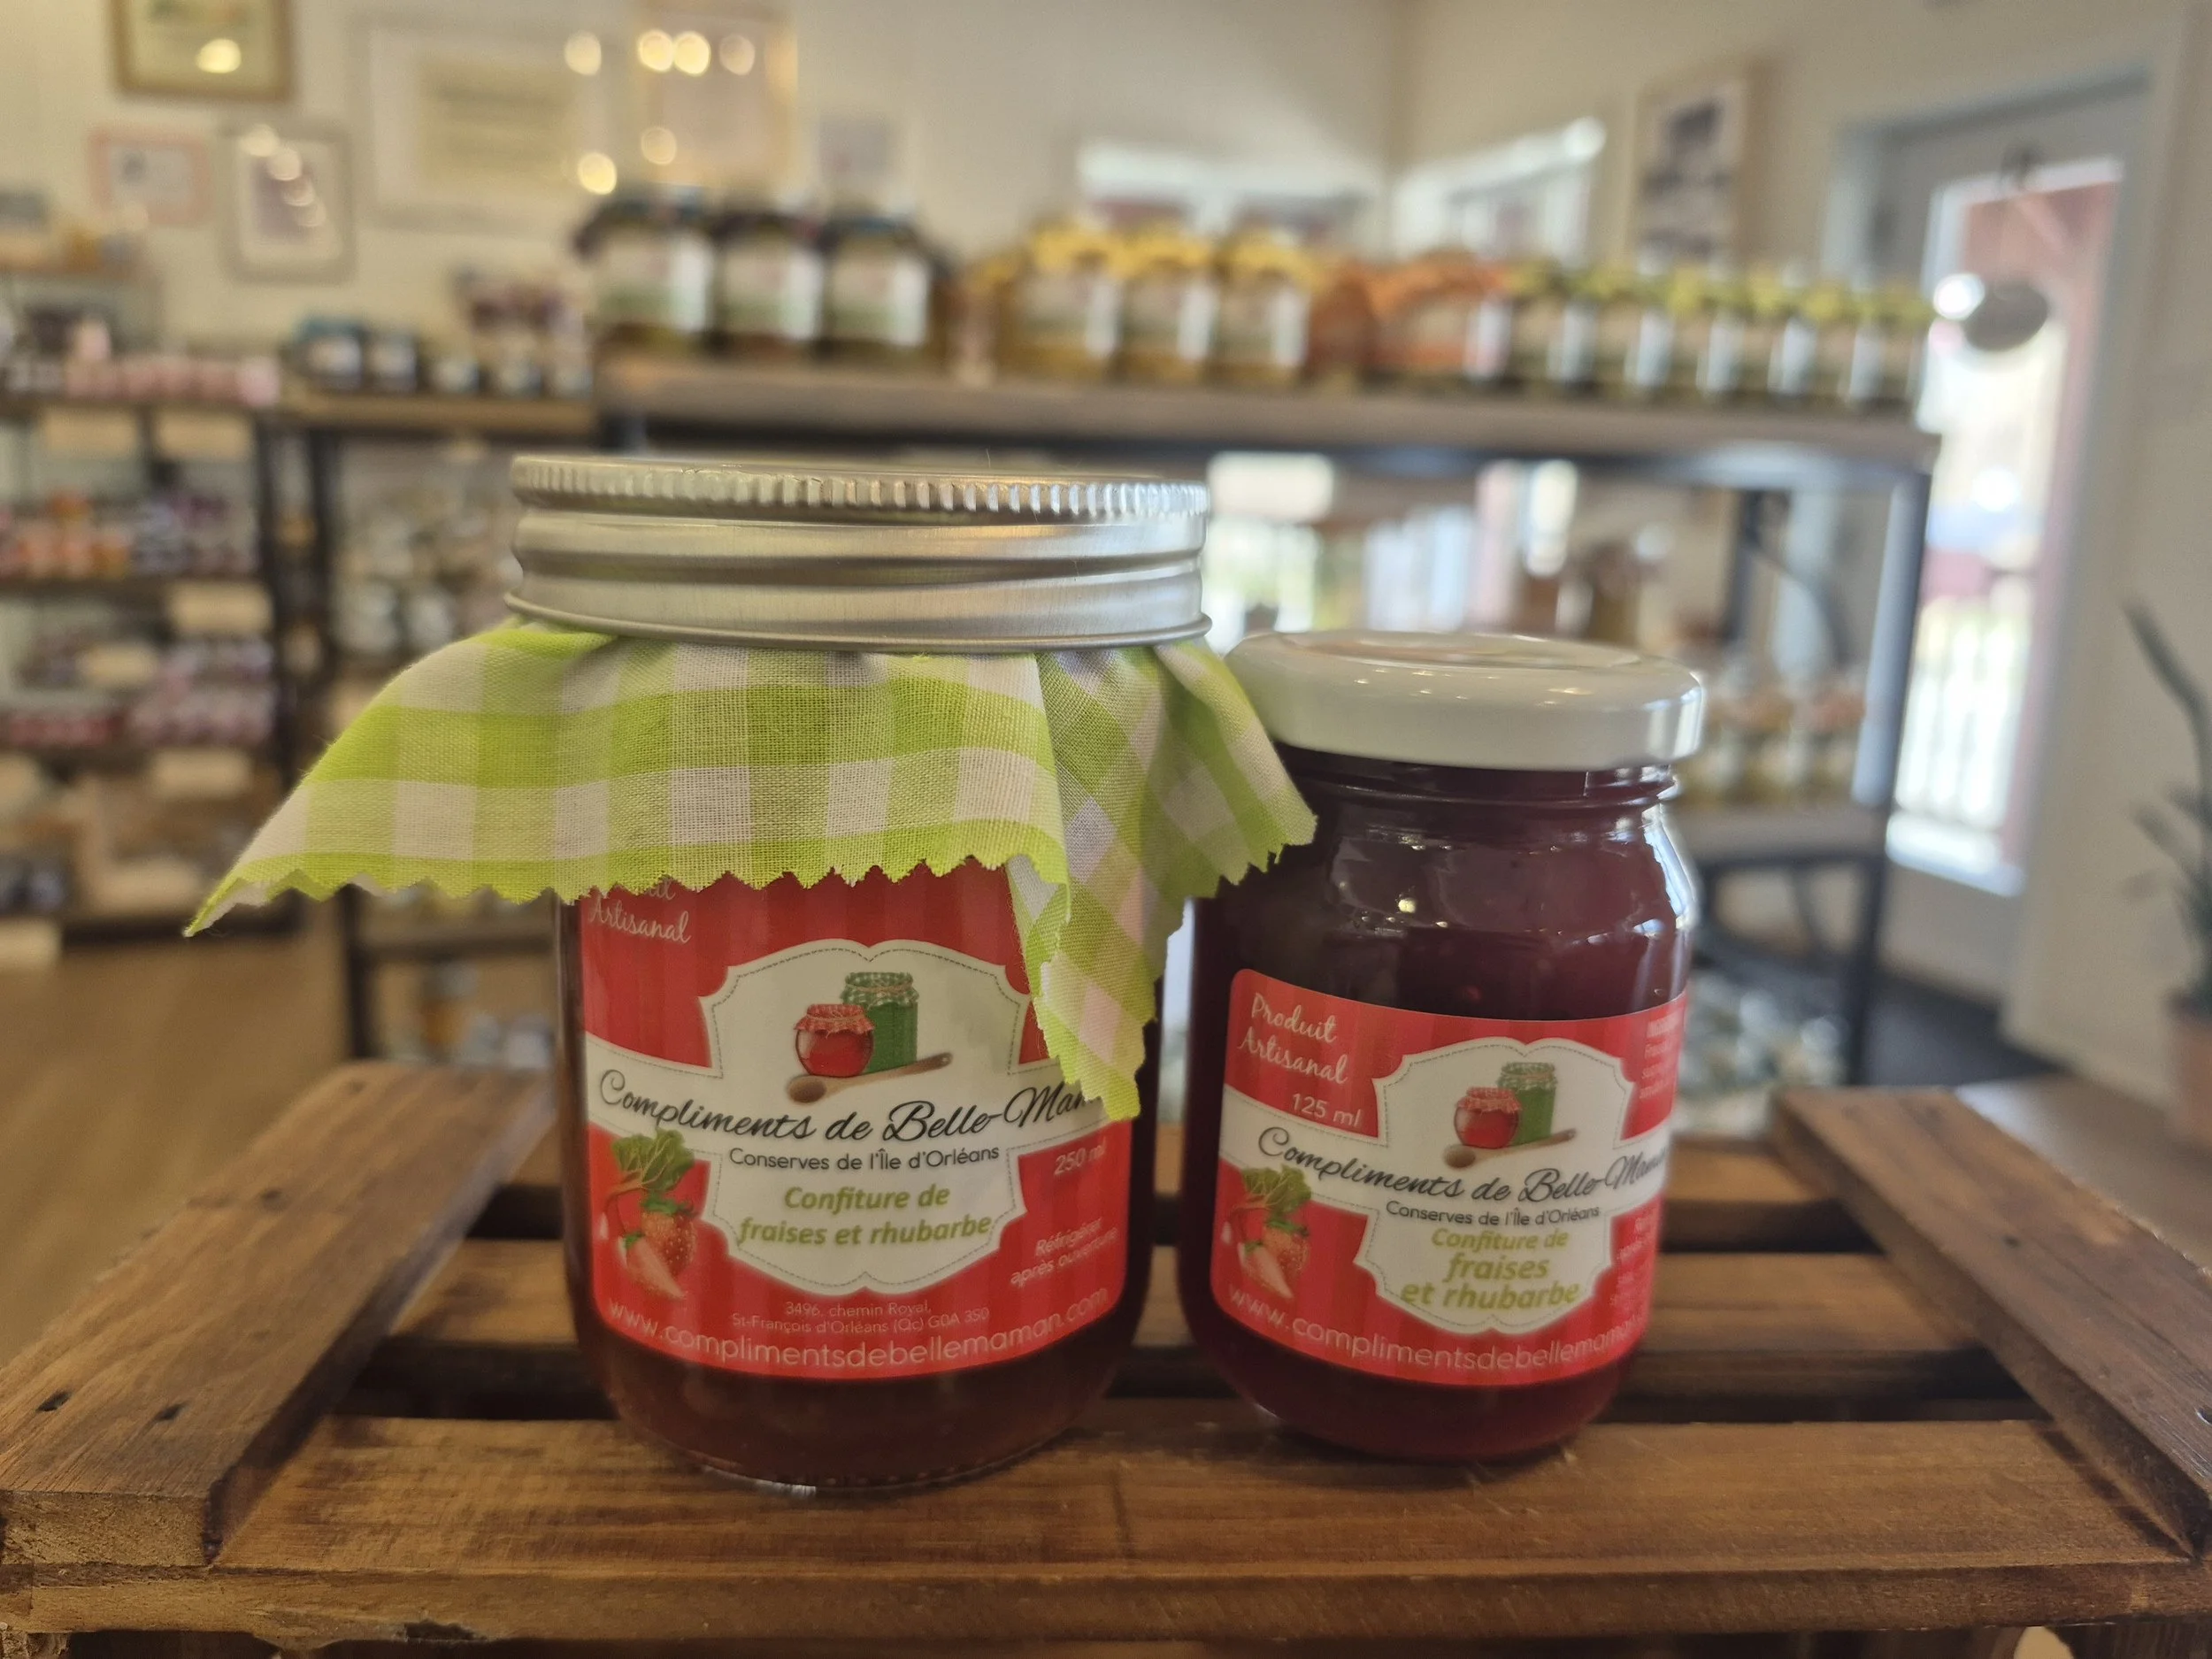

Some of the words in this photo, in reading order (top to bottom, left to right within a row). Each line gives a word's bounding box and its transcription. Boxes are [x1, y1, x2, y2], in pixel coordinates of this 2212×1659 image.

[589, 895, 691, 943] Artisanal
[1251, 992, 1338, 1043] Produit
[1238, 1026, 1348, 1085] Artisanal
[600, 1069, 817, 1140] Compliments
[825, 1111, 872, 1141] de
[882, 1081, 1102, 1142] Belle-Ma
[1292, 1093, 1327, 1118] 125
[1333, 1108, 1362, 1127] ml
[729, 1148, 830, 1171] Conserves
[836, 1151, 863, 1170] de
[870, 1148, 902, 1170] l'Île
[909, 1146, 1000, 1170] d'Orléans
[1054, 1148, 1087, 1176] 250
[1258, 1126, 1464, 1198] Compliments
[1471, 1177, 1511, 1202] de
[784, 1186, 910, 1215] Confiture
[918, 1184, 950, 1209] de
[1386, 1201, 1471, 1225] Conserves
[1479, 1211, 1500, 1225] de
[1535, 1207, 1600, 1225] d'Orléans
[738, 1217, 826, 1246] fraises
[835, 1225, 861, 1245] et
[870, 1214, 993, 1245] rhubarbe
[1432, 1228, 1539, 1253] Confiture
[1543, 1227, 1570, 1248] de
[1010, 1259, 1055, 1286] après
[1441, 1251, 1550, 1283] fraises
[830, 1302, 883, 1317] chemin
[1401, 1283, 1435, 1305] et
[1443, 1280, 1580, 1310] rhubarbe
[610, 1288, 1109, 1368] www.complimentsdebellemaman.com
[817, 1319, 889, 1334] d'Orléans
